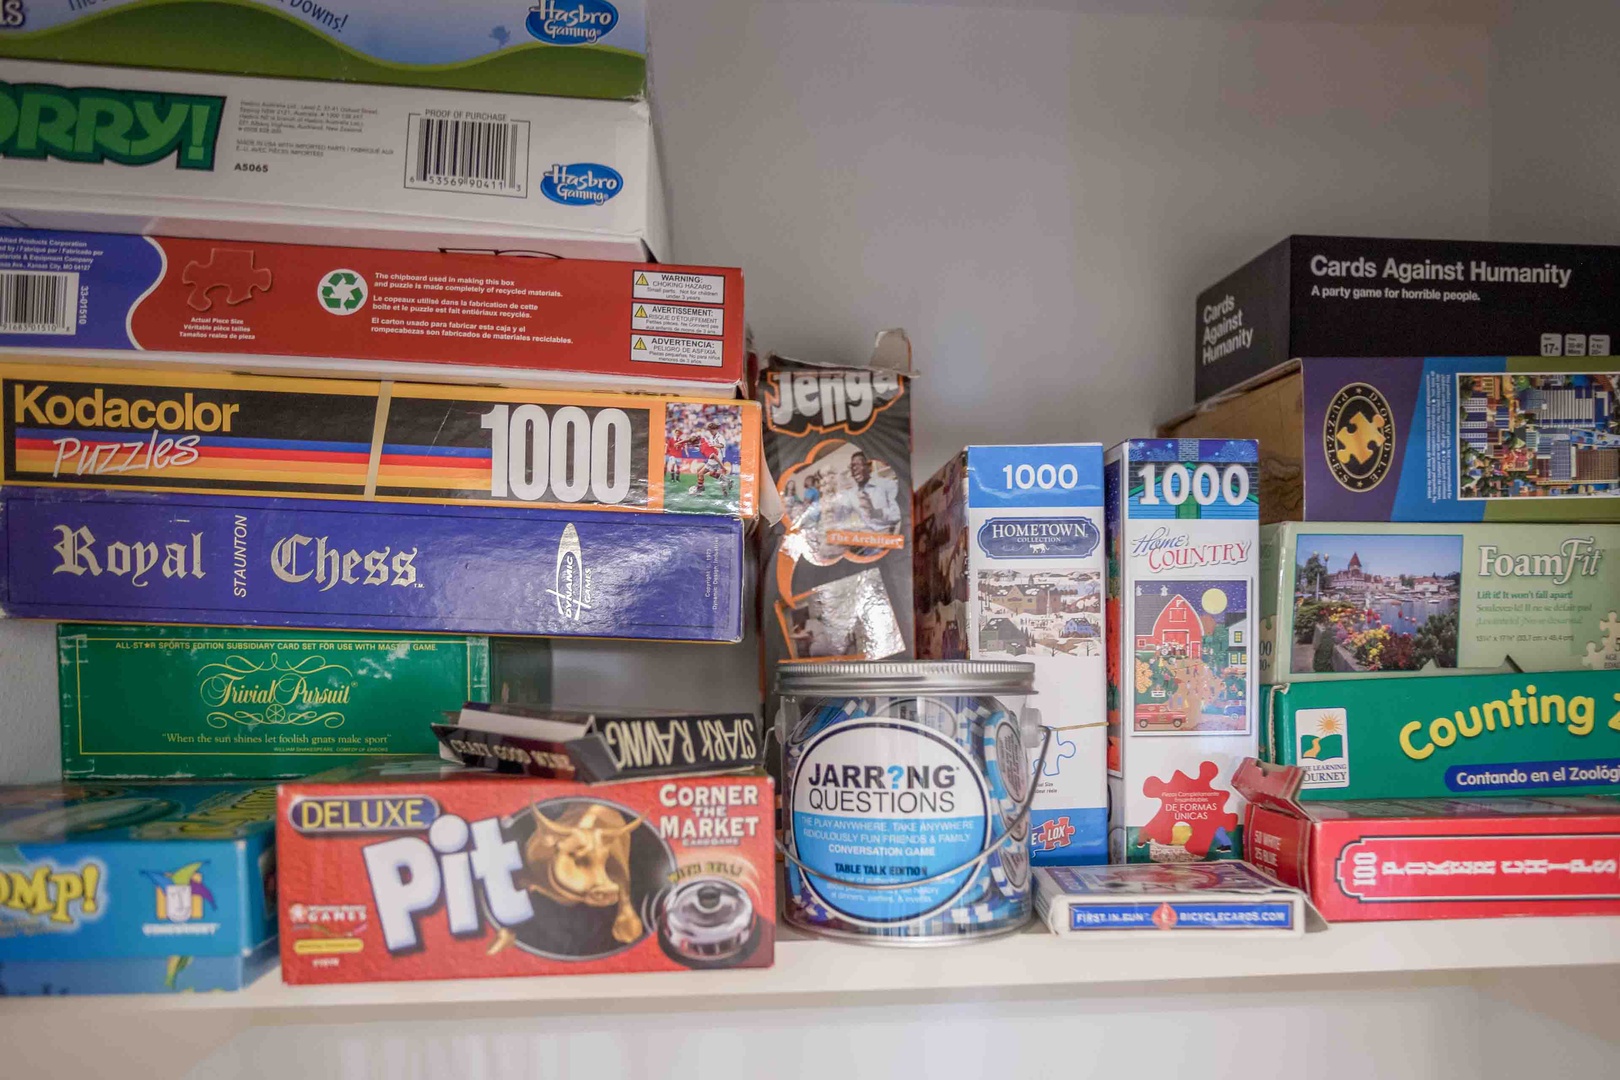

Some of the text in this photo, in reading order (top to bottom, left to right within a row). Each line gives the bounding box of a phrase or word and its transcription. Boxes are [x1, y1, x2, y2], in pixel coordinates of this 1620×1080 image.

[528, 0, 612, 25] Hasbro
[543, 19, 602, 43] Gaming
[424, 108, 508, 121] PROOF OF PURCHASE
[234, 163, 269, 173] A5065
[543, 164, 618, 191] Hasbro
[429, 175, 464, 187] 53569
[556, 184, 604, 206] Gaming
[375, 272, 515, 287] The chipboard used in making this box
[661, 274, 703, 284] WARNING:
[1311, 254, 1572, 288] Cards Against Humanity
[374, 280, 564, 298] and puzzle is made completely of recycled materials.
[652, 281, 712, 291] CHOKING HAZARD
[1311, 285, 1480, 302] A party game for horrible people.
[652, 306, 714, 317] AVERTISSEMENT:
[1203, 294, 1236, 324] Cards
[238, 333, 256, 341] pieza
[1203, 310, 1243, 346] Against
[651, 337, 715, 349] ADVERTENCIA:
[653, 345, 680, 353] PELIGRO
[691, 347, 717, 355] ASFIXIA
[1203, 328, 1254, 365] Humanity
[1543, 343, 1559, 354] 17+
[14, 384, 240, 433] Kodacolor
[52, 429, 201, 479] Puzzles
[480, 404, 632, 505] 1000
[1002, 463, 1078, 490] 1000
[1137, 463, 1250, 506] 1000
[992, 523, 1087, 539] HOMETOWN
[52, 523, 207, 588] Royal
[233, 514, 248, 598] STAUNTON
[270, 533, 418, 593] Chess
[1148, 542, 1251, 571] COUNTRY
[1478, 536, 1602, 586] FoamFit
[565, 555, 574, 619] DYNAMIC
[584, 567, 592, 604] GAMES
[1477, 590, 1492, 599] Lift
[1502, 590, 1509, 599] It
[1511, 590, 1535, 599] won't
[1535, 590, 1548, 599] fall
[158, 641, 190, 650] SPORTS
[192, 642, 225, 650] EDITION
[226, 642, 275, 650] SUBSIDIARY
[277, 642, 300, 650] CARD
[355, 643, 376, 651] WITH
[200, 673, 350, 708] Trivial Pursuit
[1399, 684, 1595, 761] Counting
[197, 733, 212, 744] the
[214, 735, 231, 744] sun
[233, 733, 262, 744] shines
[264, 733, 277, 744] let
[279, 733, 309, 744] foolish
[311, 735, 336, 745] gnats
[338, 734, 362, 744] make
[697, 719, 757, 762] STARK
[808, 763, 956, 790] JARR?NG
[1303, 771, 1347, 782] OURNEY
[1312, 763, 1347, 772] LEARNING
[1456, 768, 1527, 786] Contando
[1530, 771, 1549, 783] en
[1552, 767, 1566, 782] el
[659, 783, 758, 807] CORNER
[809, 788, 955, 814] QUESTIONS
[301, 799, 424, 829] DELUXE
[692, 806, 727, 818] THE
[1165, 802, 1218, 812] DE FORMAS
[659, 815, 759, 839] MARKET
[813, 818, 832, 828] PLAY
[893, 822, 917, 831] TAKE
[919, 820, 974, 831] ANYWHERE
[1047, 824, 1066, 842] LOX
[803, 829, 971, 844] RIDICULOUSLY FUN FRIENDS & FAMILY
[828, 844, 936, 857] CONVERSATION GAME
[834, 863, 928, 876] TABLE TALK EDITION
[362, 814, 534, 952] Pit
